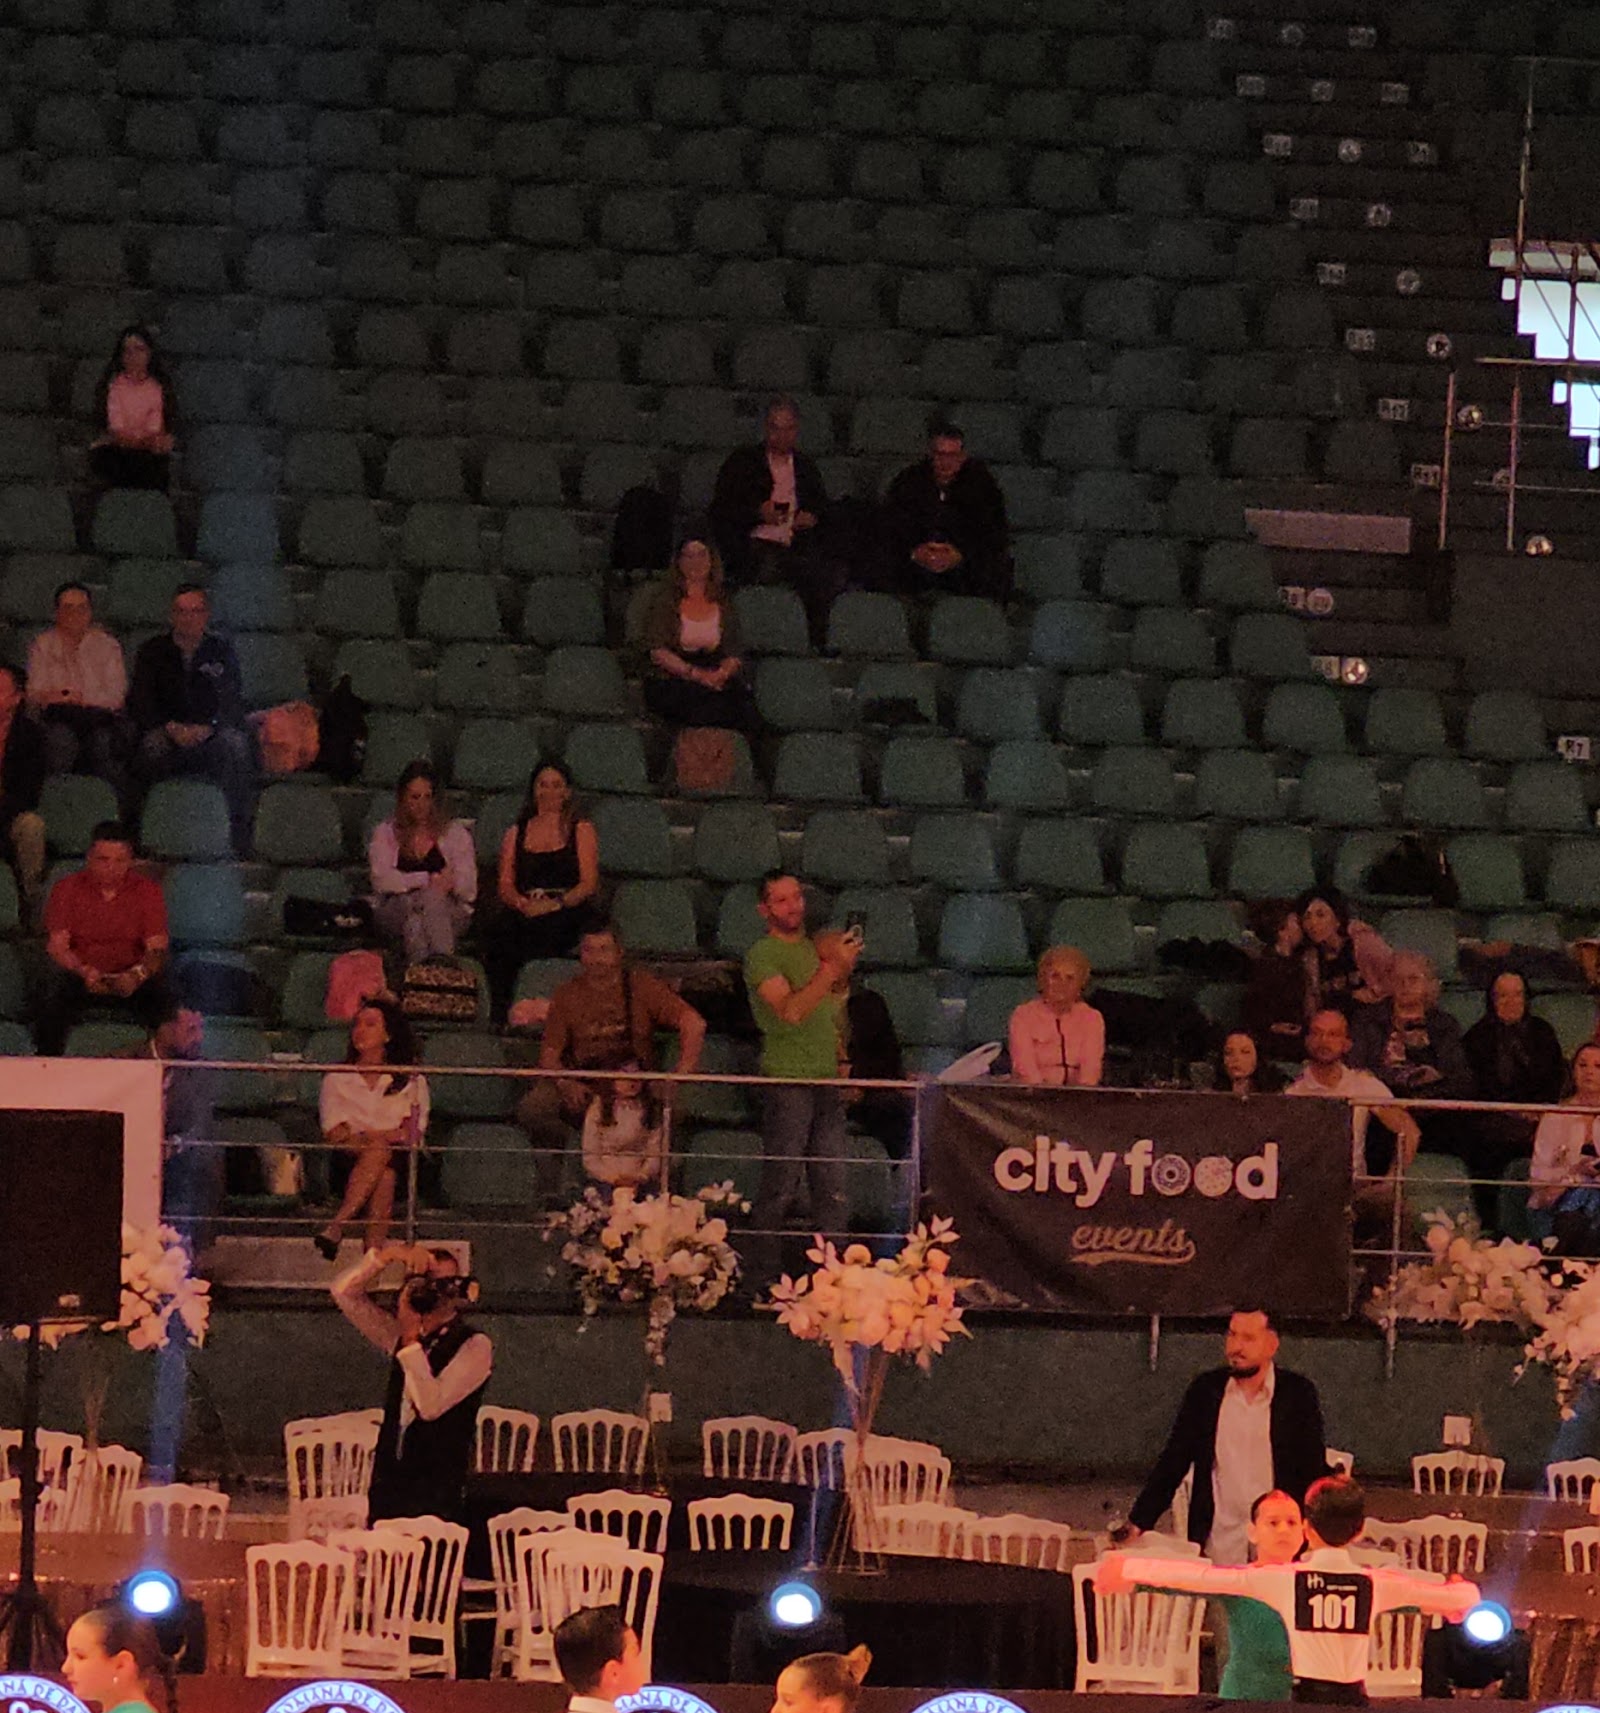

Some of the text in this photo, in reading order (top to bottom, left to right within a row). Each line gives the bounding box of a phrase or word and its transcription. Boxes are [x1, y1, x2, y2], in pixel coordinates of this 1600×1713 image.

[1565, 739, 1584, 757] R7
[993, 1135, 1279, 1208] city food
[1071, 1217, 1194, 1256] events
[1308, 1593, 1356, 1630] 101
